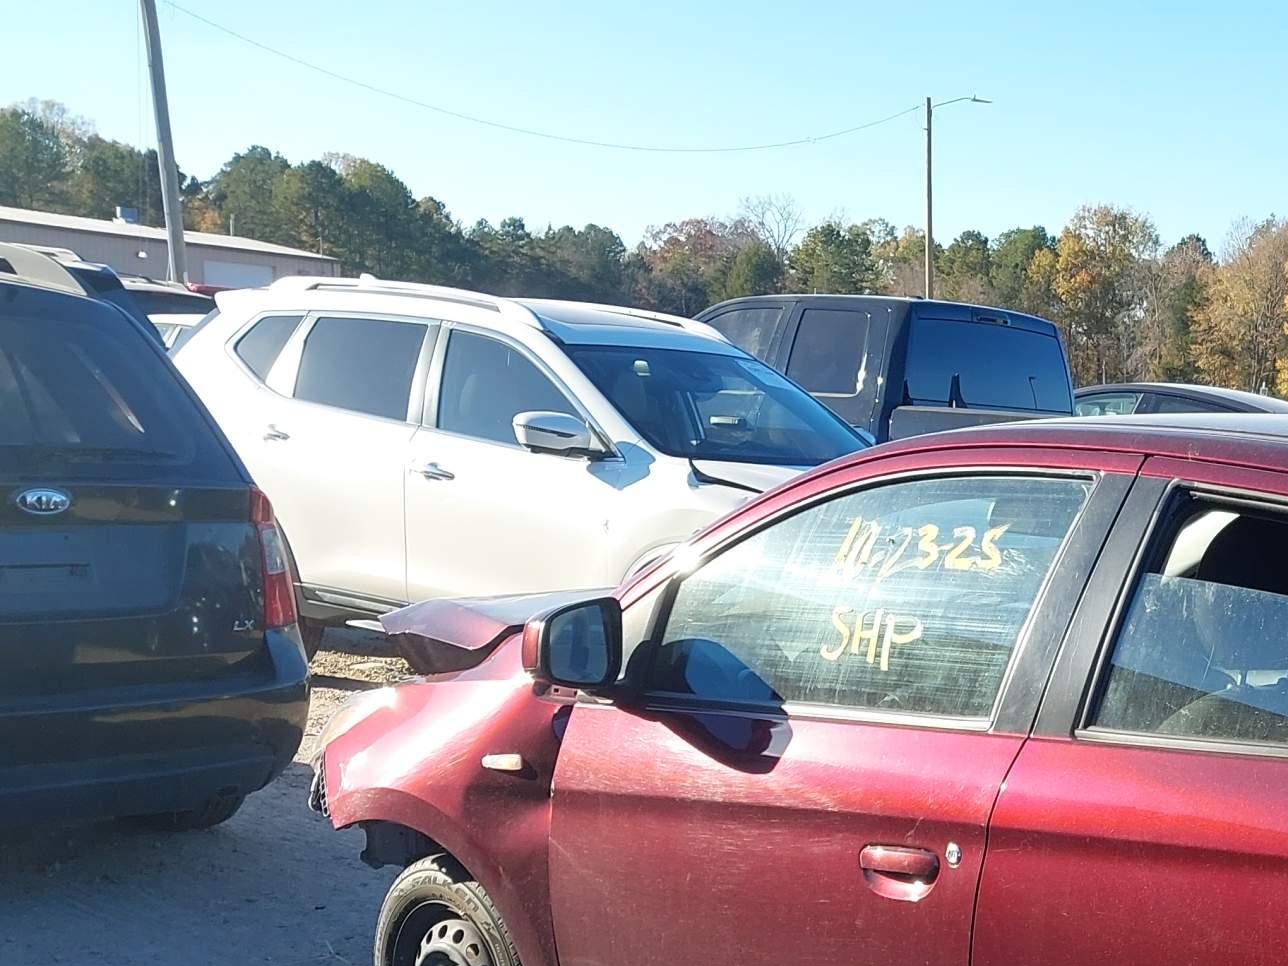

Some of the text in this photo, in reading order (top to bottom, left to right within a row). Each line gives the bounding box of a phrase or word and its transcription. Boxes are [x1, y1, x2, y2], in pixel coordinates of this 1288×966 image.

[24, 494, 65, 510] KIA
[233, 620, 254, 630] LX
[820, 607, 923, 671] SHP
